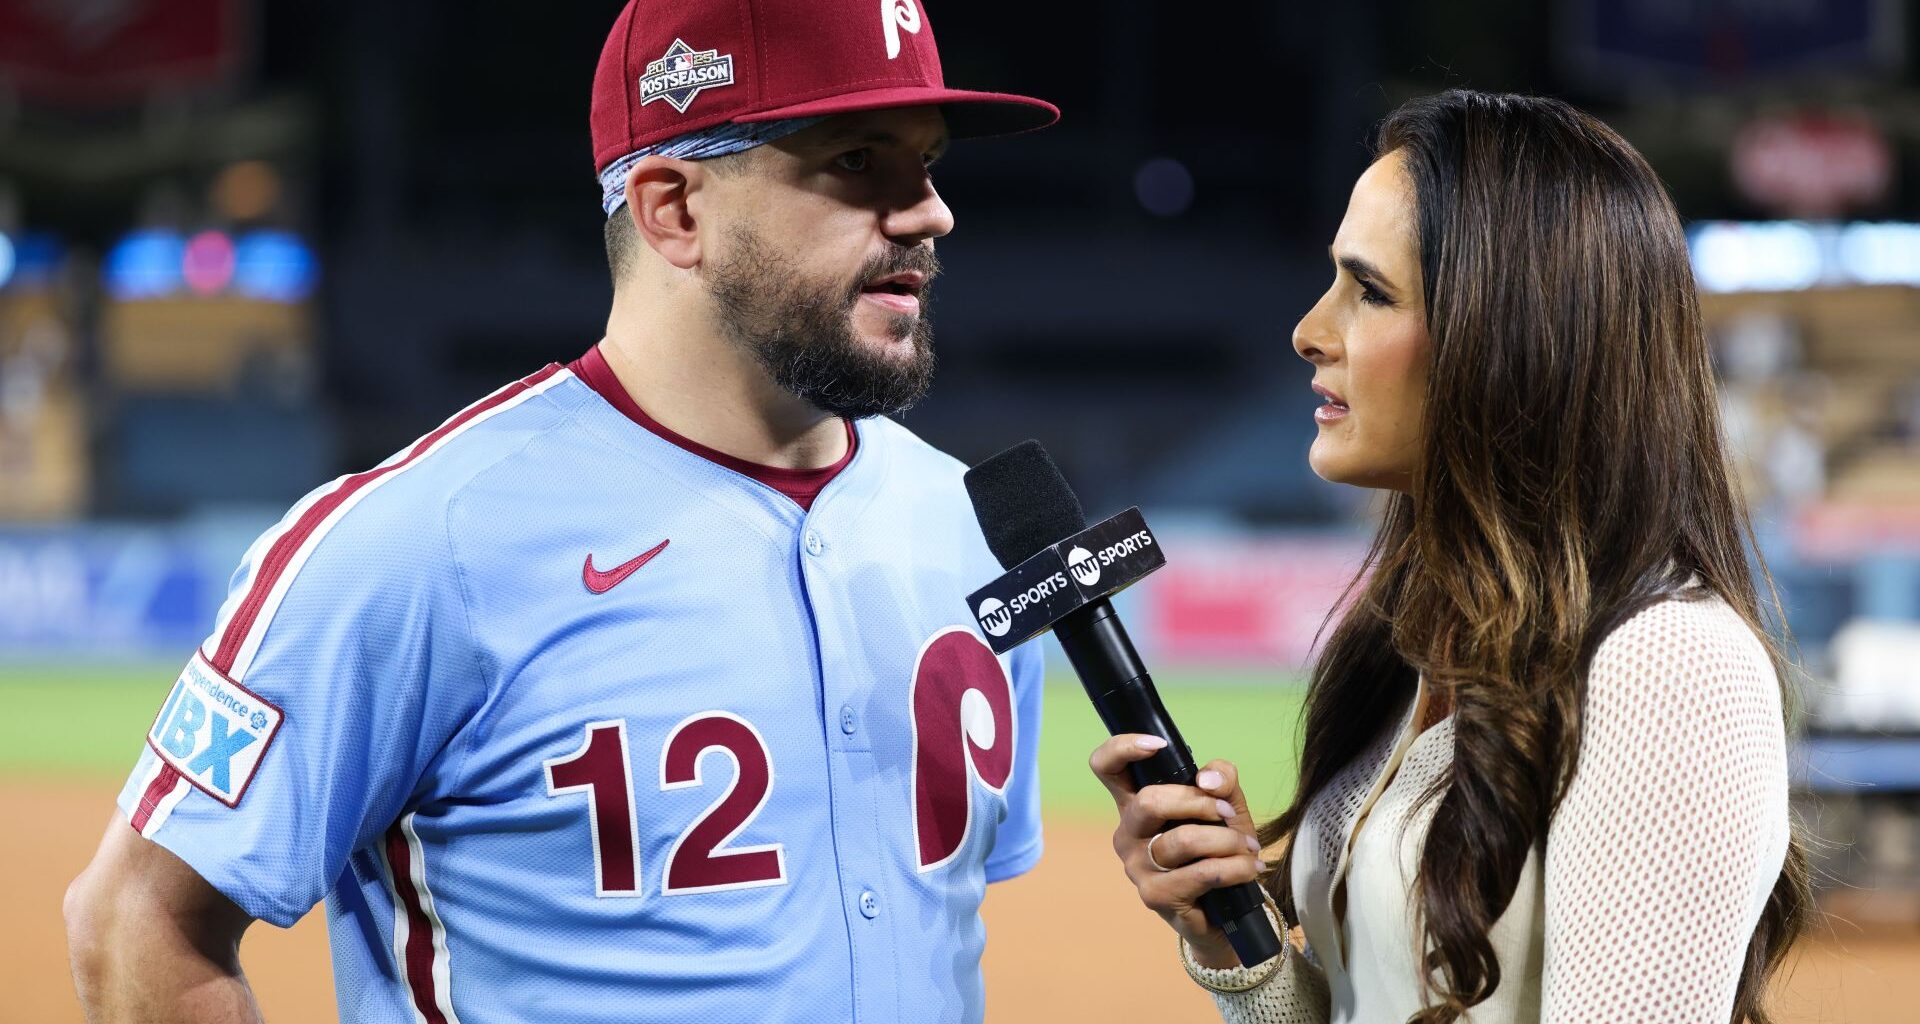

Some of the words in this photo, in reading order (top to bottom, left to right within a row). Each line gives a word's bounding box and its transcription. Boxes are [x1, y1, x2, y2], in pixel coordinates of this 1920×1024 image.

[640, 63, 728, 98] POSTSEASON
[648, 61, 664, 76] 20
[693, 53, 713, 65] 25
[1068, 550, 1101, 585] TNT
[1098, 530, 1152, 566] SPORTS
[979, 600, 1012, 635] TNT
[1009, 571, 1068, 615] SPORTS
[153, 678, 258, 795] IBX
[909, 624, 1018, 874] P
[543, 710, 787, 898] 12
